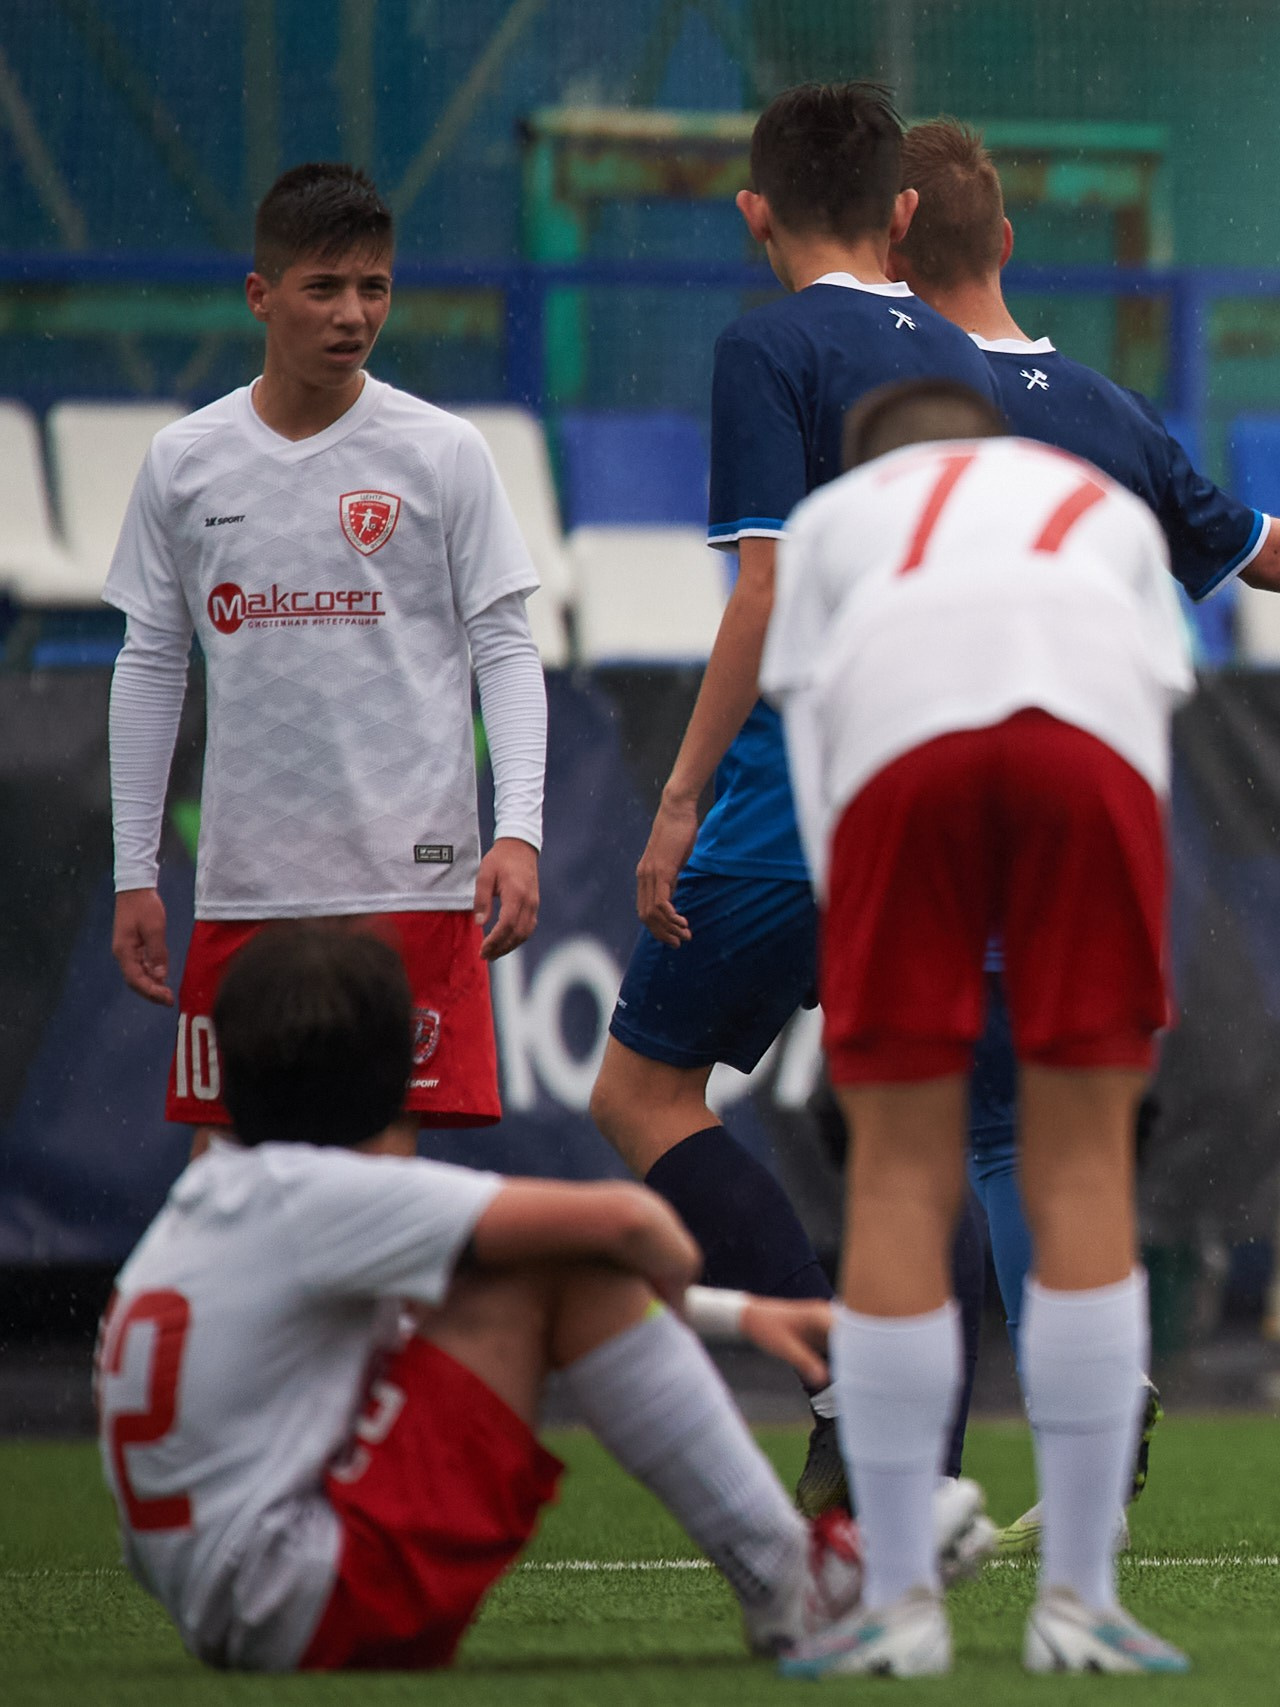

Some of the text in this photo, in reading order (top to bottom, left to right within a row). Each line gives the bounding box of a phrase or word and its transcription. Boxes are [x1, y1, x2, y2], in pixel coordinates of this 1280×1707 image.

[870, 442, 1108, 574] 77
[217, 514, 246, 526] SPORT
[247, 616, 379, 629] СИСТЕМНАЯ ИНТЕГРАЦИЯ
[176, 1013, 220, 1100] 10
[410, 1079, 440, 1088] SPORT
